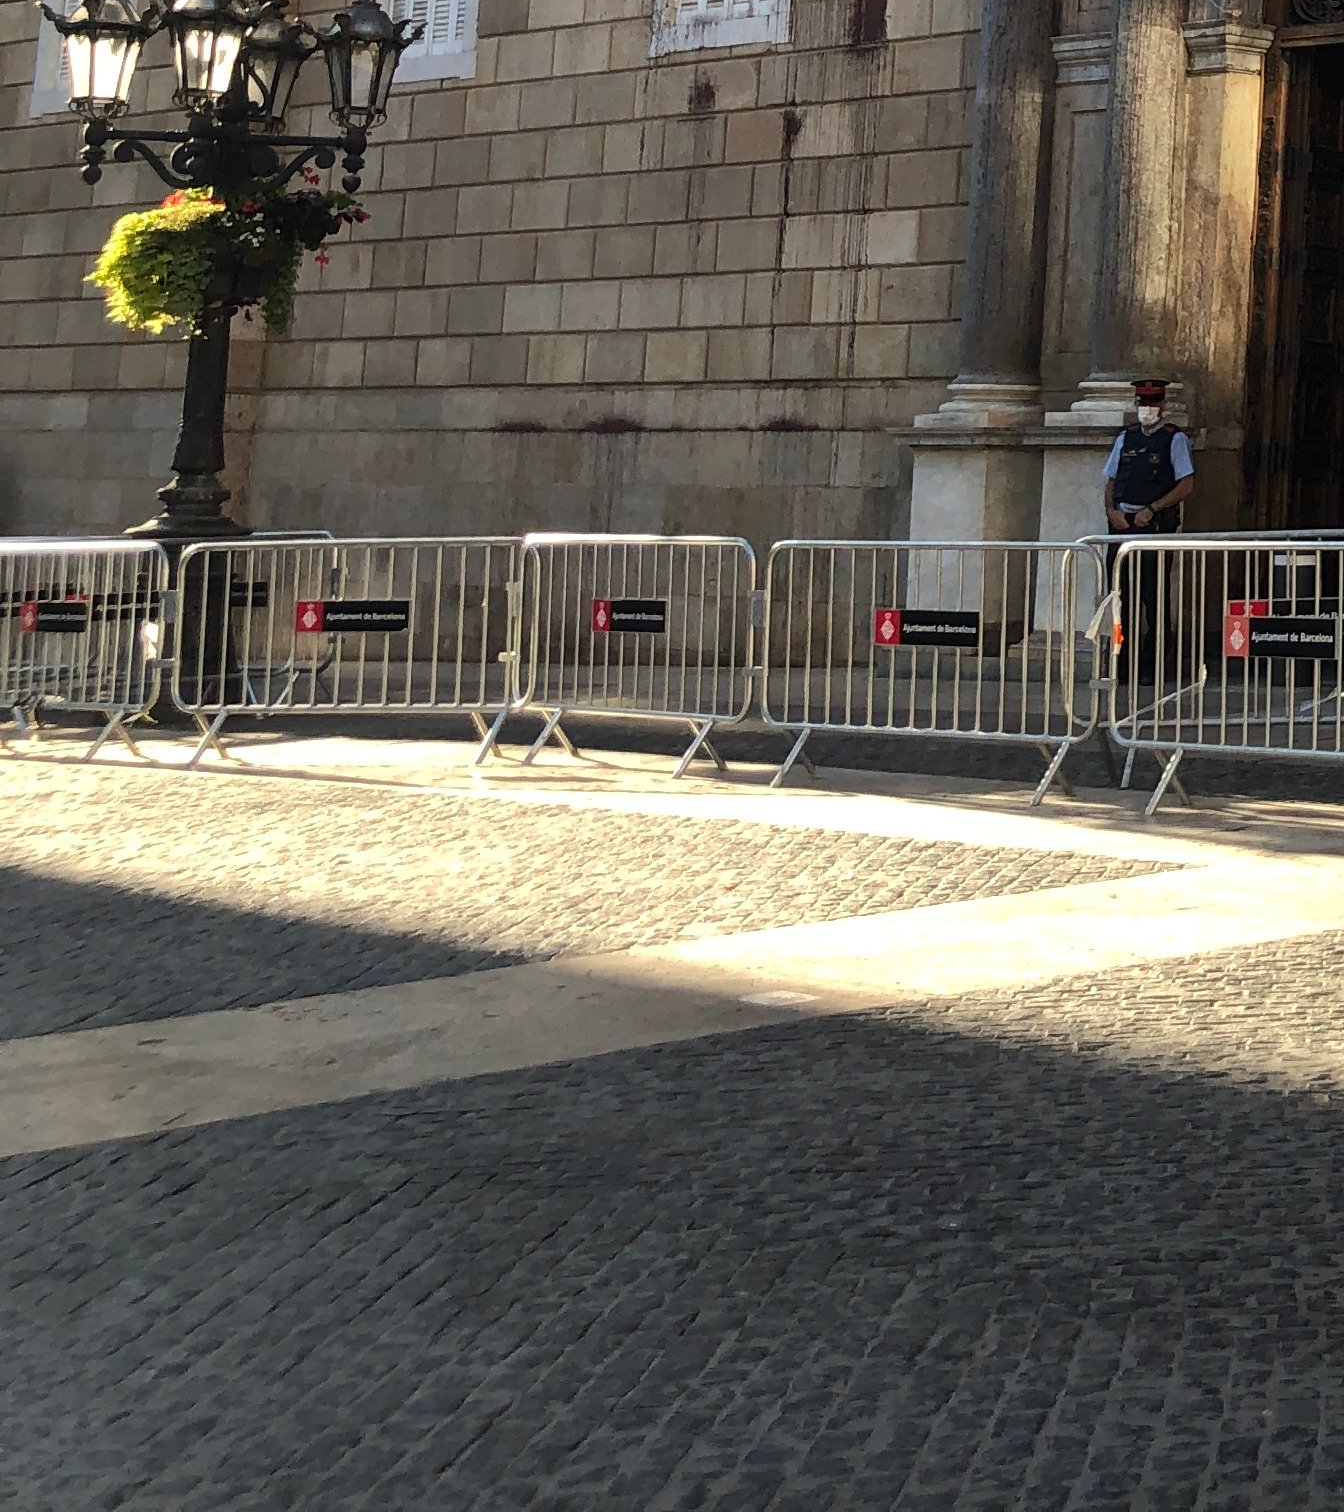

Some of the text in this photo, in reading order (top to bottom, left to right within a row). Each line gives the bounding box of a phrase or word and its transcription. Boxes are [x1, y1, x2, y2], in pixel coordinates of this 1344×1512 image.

[1251, 630, 1334, 643] Ajuntament de Barcelona
